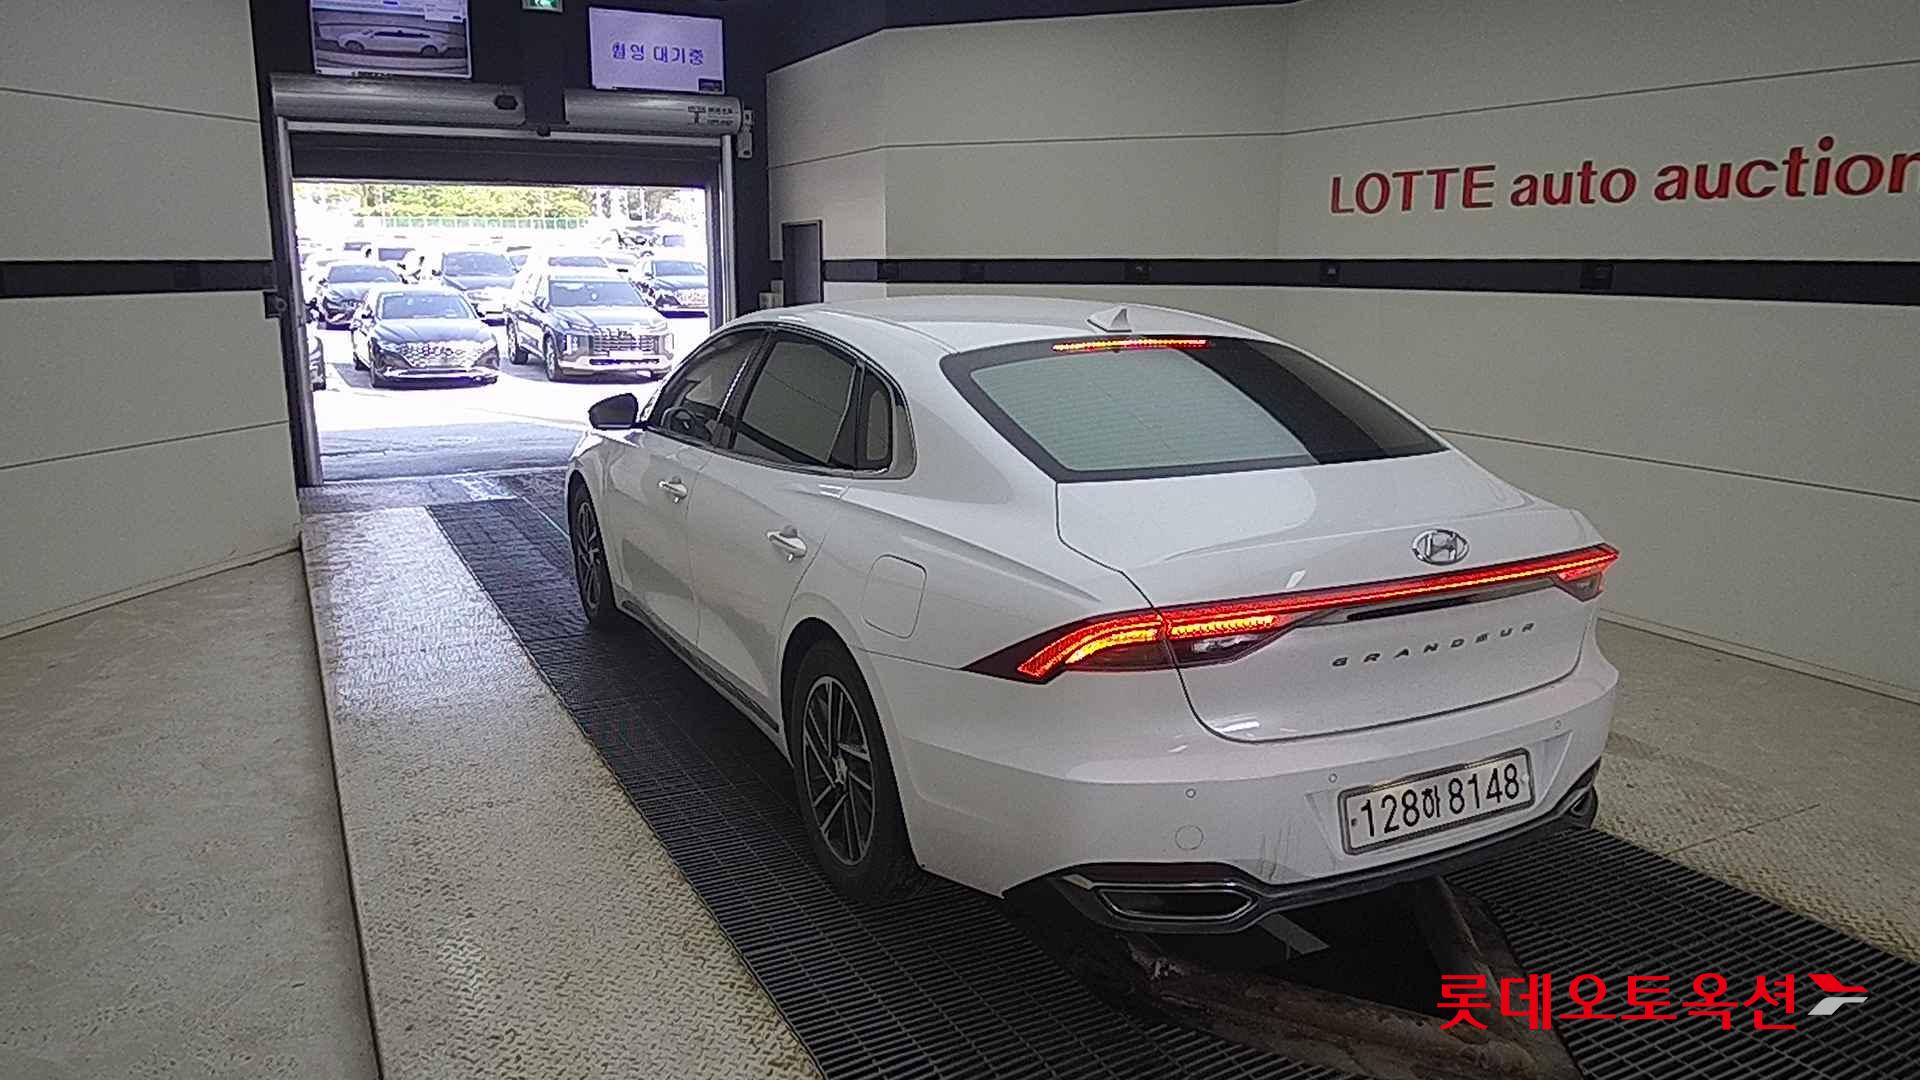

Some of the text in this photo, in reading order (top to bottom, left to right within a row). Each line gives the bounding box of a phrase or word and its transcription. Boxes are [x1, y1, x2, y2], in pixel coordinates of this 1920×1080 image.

[1330, 165, 1496, 214] LOTTE
[1510, 161, 1637, 206] auto
[1331, 622, 1535, 668] GRANDEUR
[1361, 763, 1520, 837] 128하 8148
